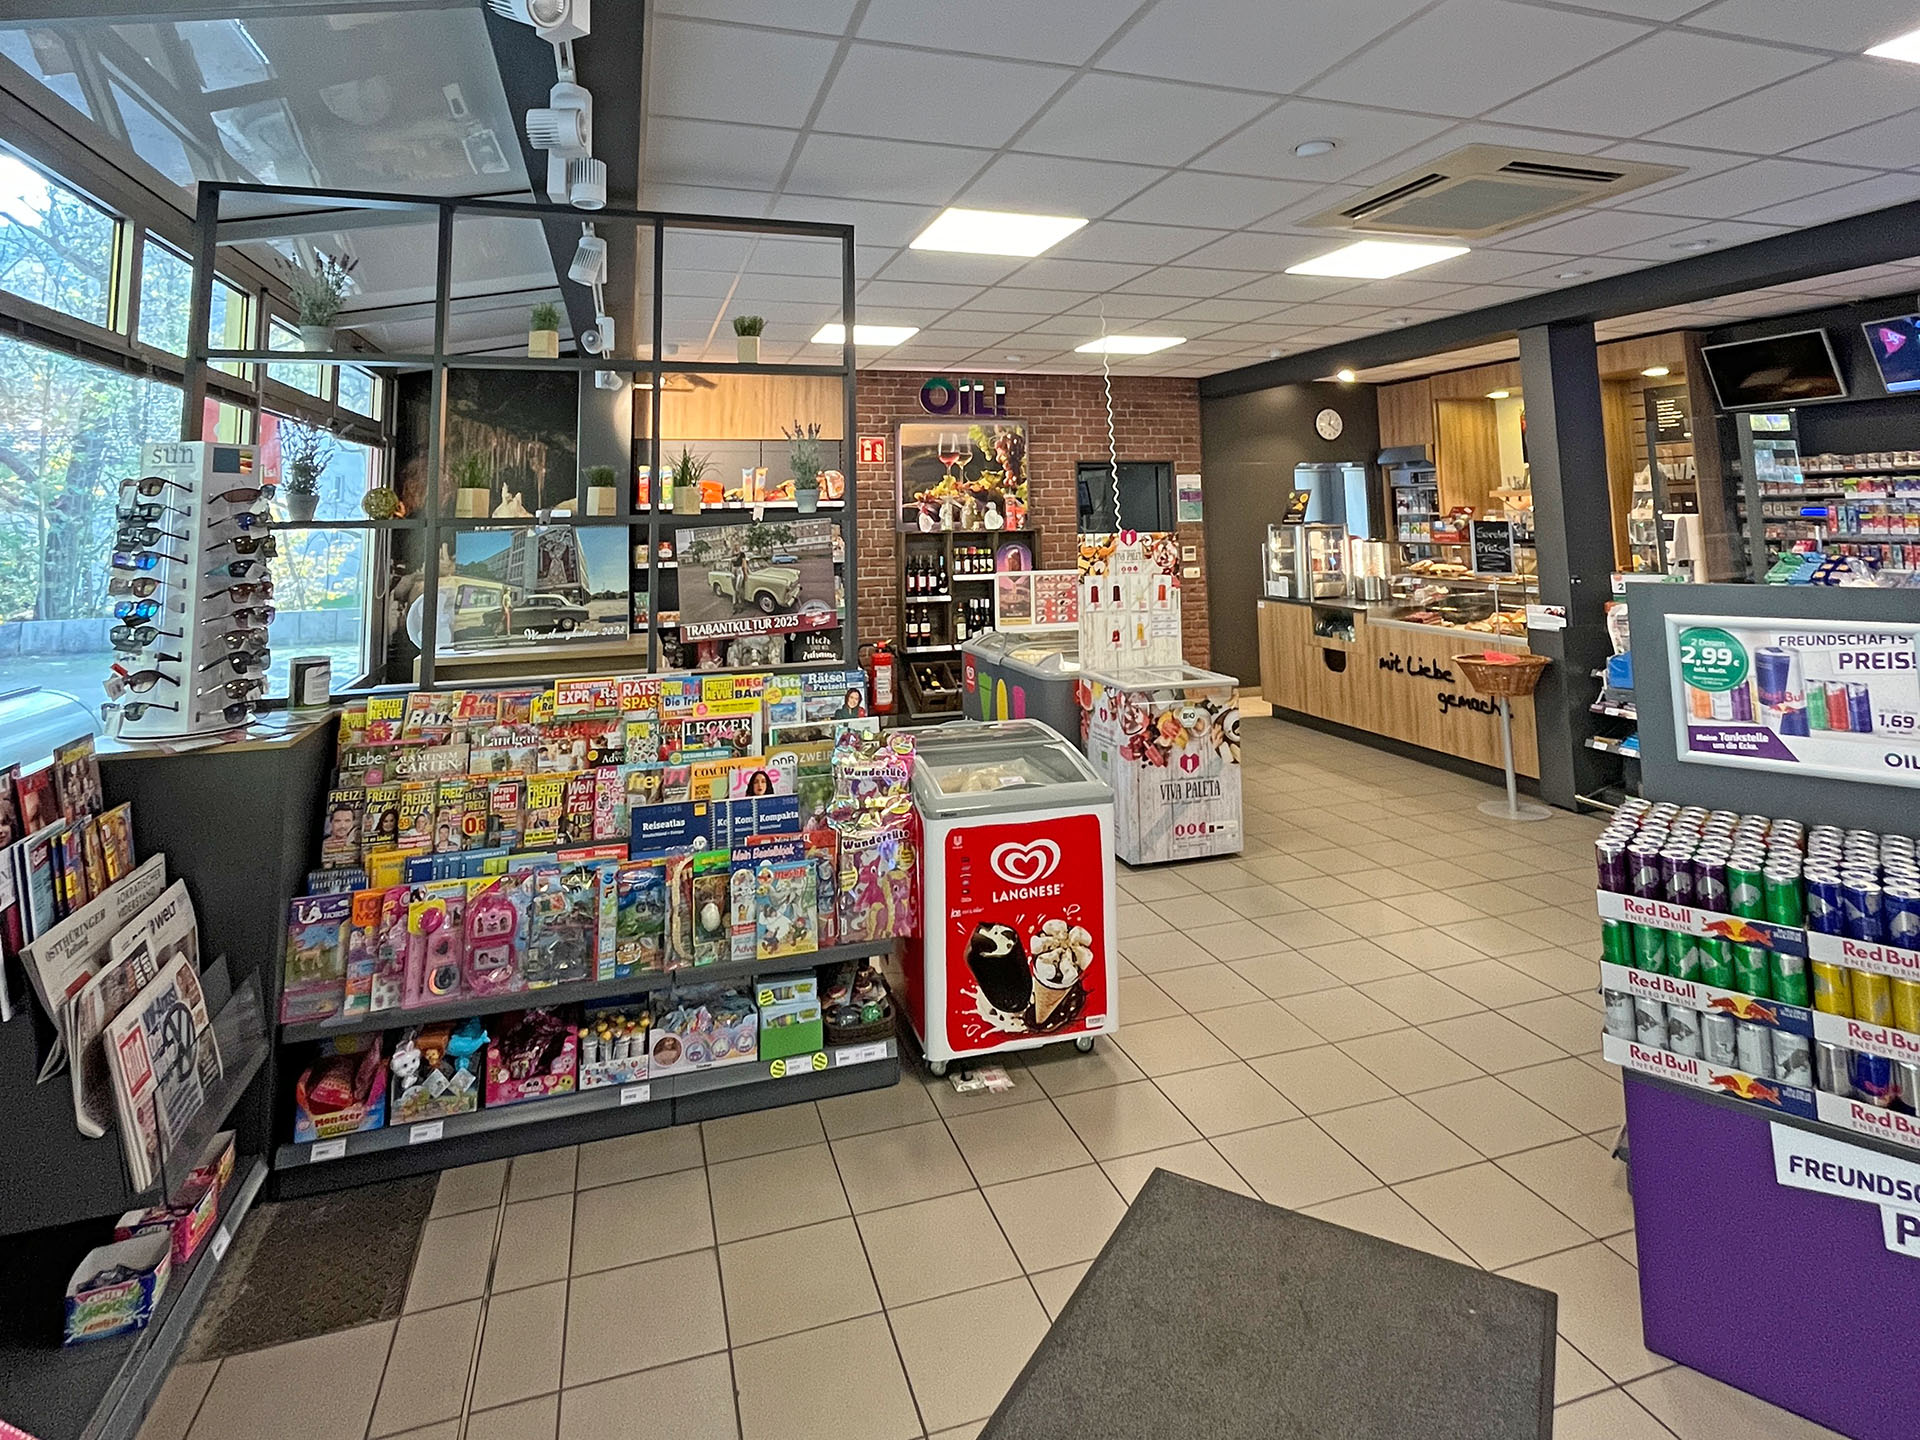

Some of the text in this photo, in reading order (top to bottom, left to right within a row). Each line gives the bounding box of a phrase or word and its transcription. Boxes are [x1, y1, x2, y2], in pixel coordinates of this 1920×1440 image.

[151, 444, 194, 464] sun
[685, 618, 772, 636] TRABANTKULTUR
[774, 616, 799, 628] 2025
[1680, 646, 1732, 666] 2,99
[1839, 652, 1917, 670] PREIS!
[1379, 652, 1456, 683] mit Liebe
[808, 672, 846, 684] Rätsel
[686, 718, 751, 736] LECKER
[395, 760, 459, 775] GARTEN
[844, 767, 907, 777] Wundertüte
[1160, 780, 1221, 801] VIVA PALETA
[642, 819, 686, 831] Reiseatlas
[843, 829, 910, 850] Wundertüte
[992, 883, 1061, 903] LANGNESE
[1624, 898, 1691, 923] Red Bull
[1625, 914, 1693, 931] ENERGY DRINK
[1843, 941, 1882, 962] Red
[1844, 957, 1888, 971] ENERGY
[1629, 971, 1696, 999] Red Bull
[1629, 986, 1698, 1007] ENERGY DRINK
[1848, 1022, 1888, 1045] Red
[1630, 1045, 1698, 1075] Red Bull
[1631, 1061, 1699, 1083] ENERGY DRINK
[1851, 1103, 1891, 1129] Red
[1852, 1121, 1897, 1138] ENERGY
